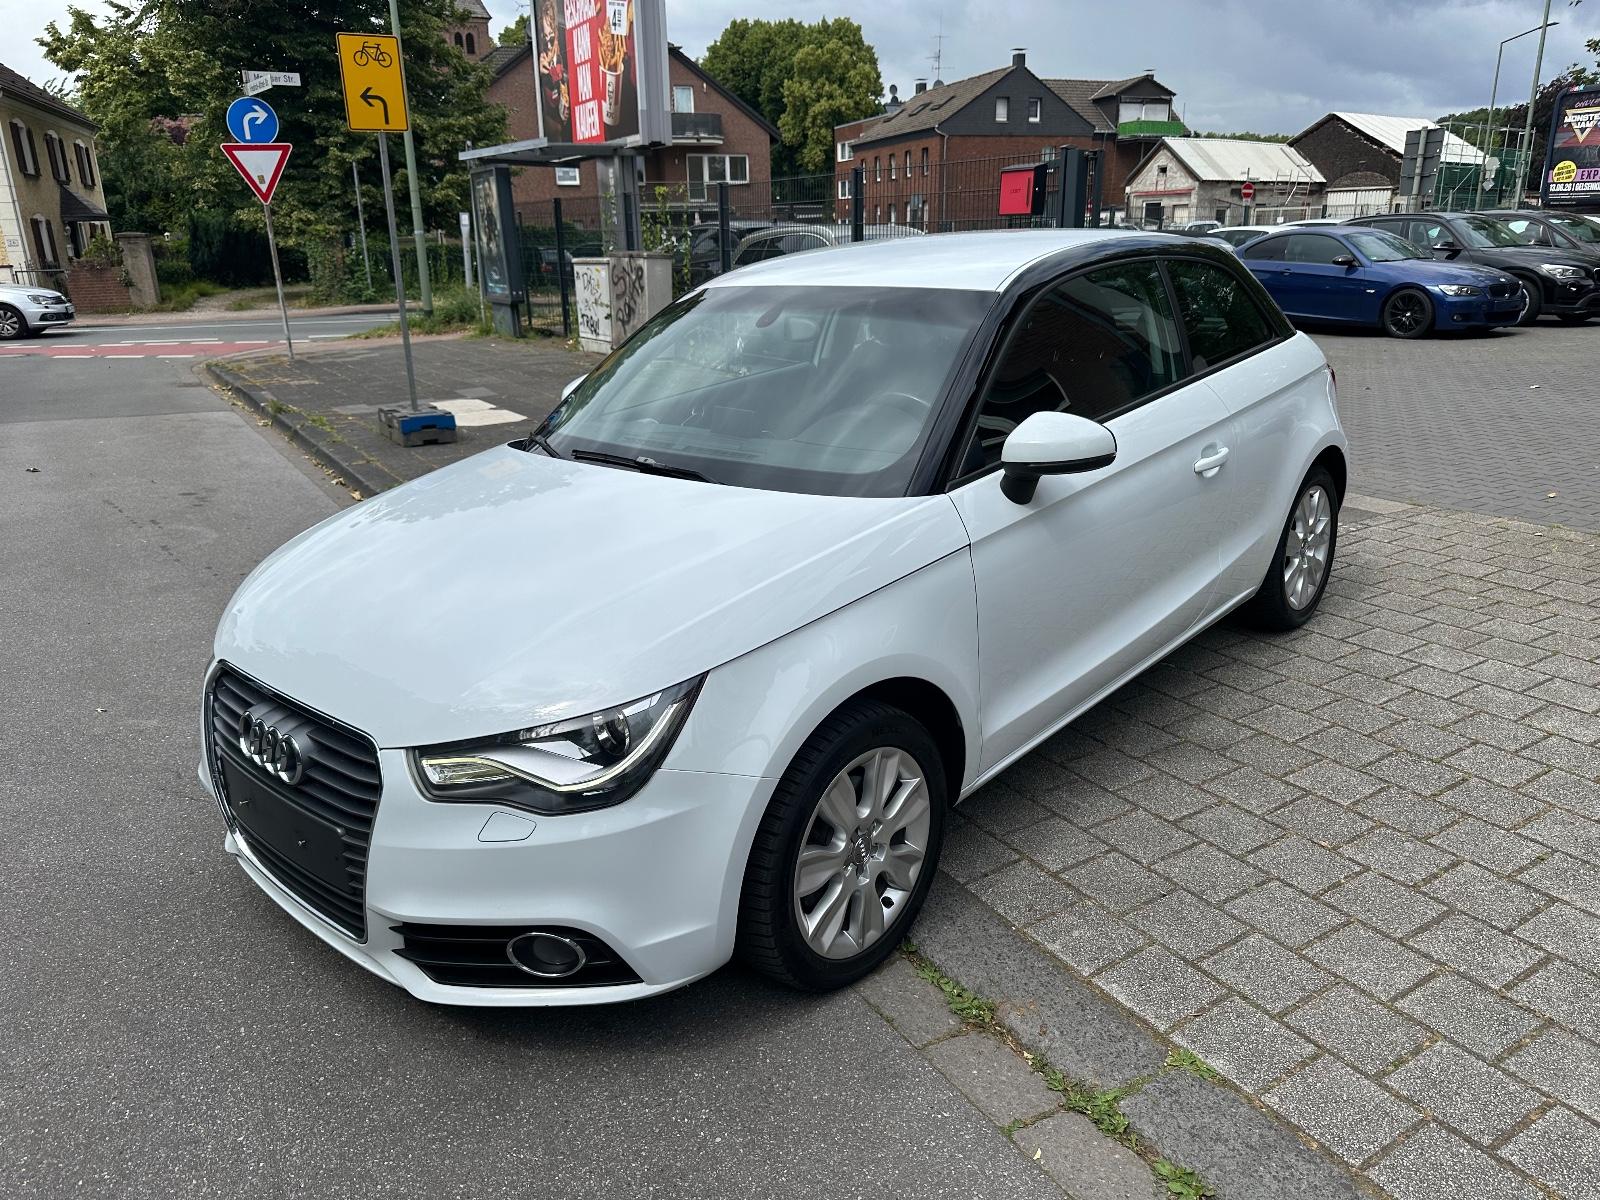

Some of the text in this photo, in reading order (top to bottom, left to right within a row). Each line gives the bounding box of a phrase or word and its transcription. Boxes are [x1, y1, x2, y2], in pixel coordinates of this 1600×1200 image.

[573, 22, 592, 65] KANN
[283, 74, 296, 84] Str.
[577, 62, 593, 103] MAN
[575, 99, 601, 141] KAUFEN
[1574, 121, 1593, 129] JAM
